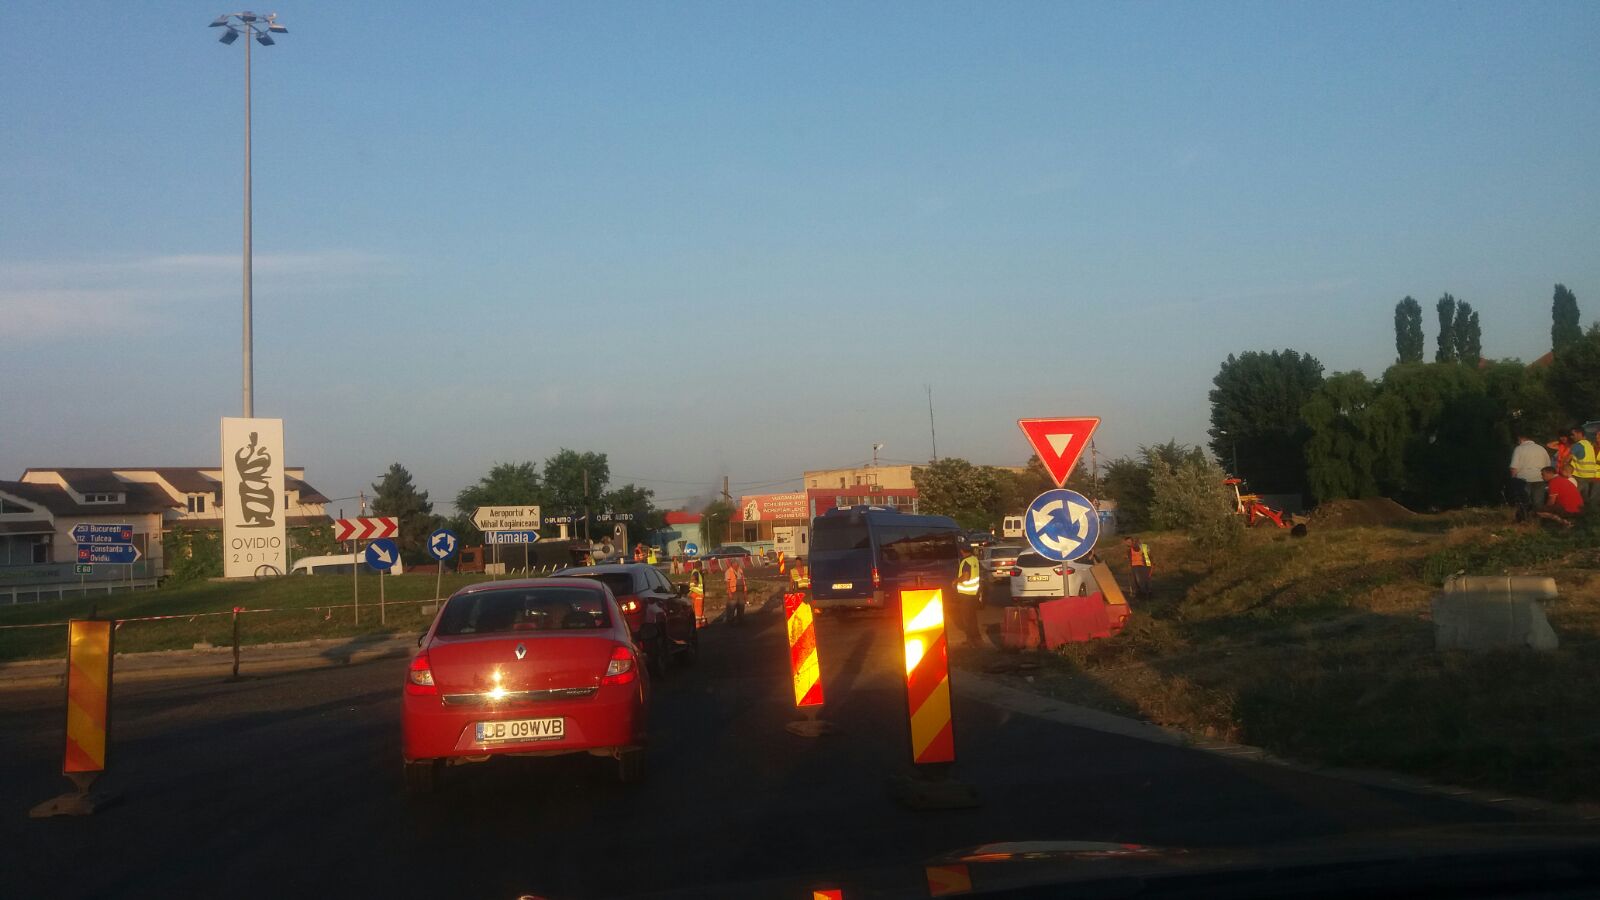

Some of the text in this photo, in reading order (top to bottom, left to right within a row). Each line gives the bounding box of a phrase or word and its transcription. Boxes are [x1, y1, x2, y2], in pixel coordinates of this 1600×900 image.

[489, 508, 524, 519] Aeroportul
[480, 519, 499, 529] Mihail
[90, 535, 112, 543] Tulcea
[231, 536, 281, 550] OVIDIO
[488, 532, 529, 544] Mamaia
[90, 553, 110, 562] Ovidiu
[233, 552, 280, 563] 2017
[76, 565, 91, 573] E 60
[511, 719, 562, 736] 09WVB
